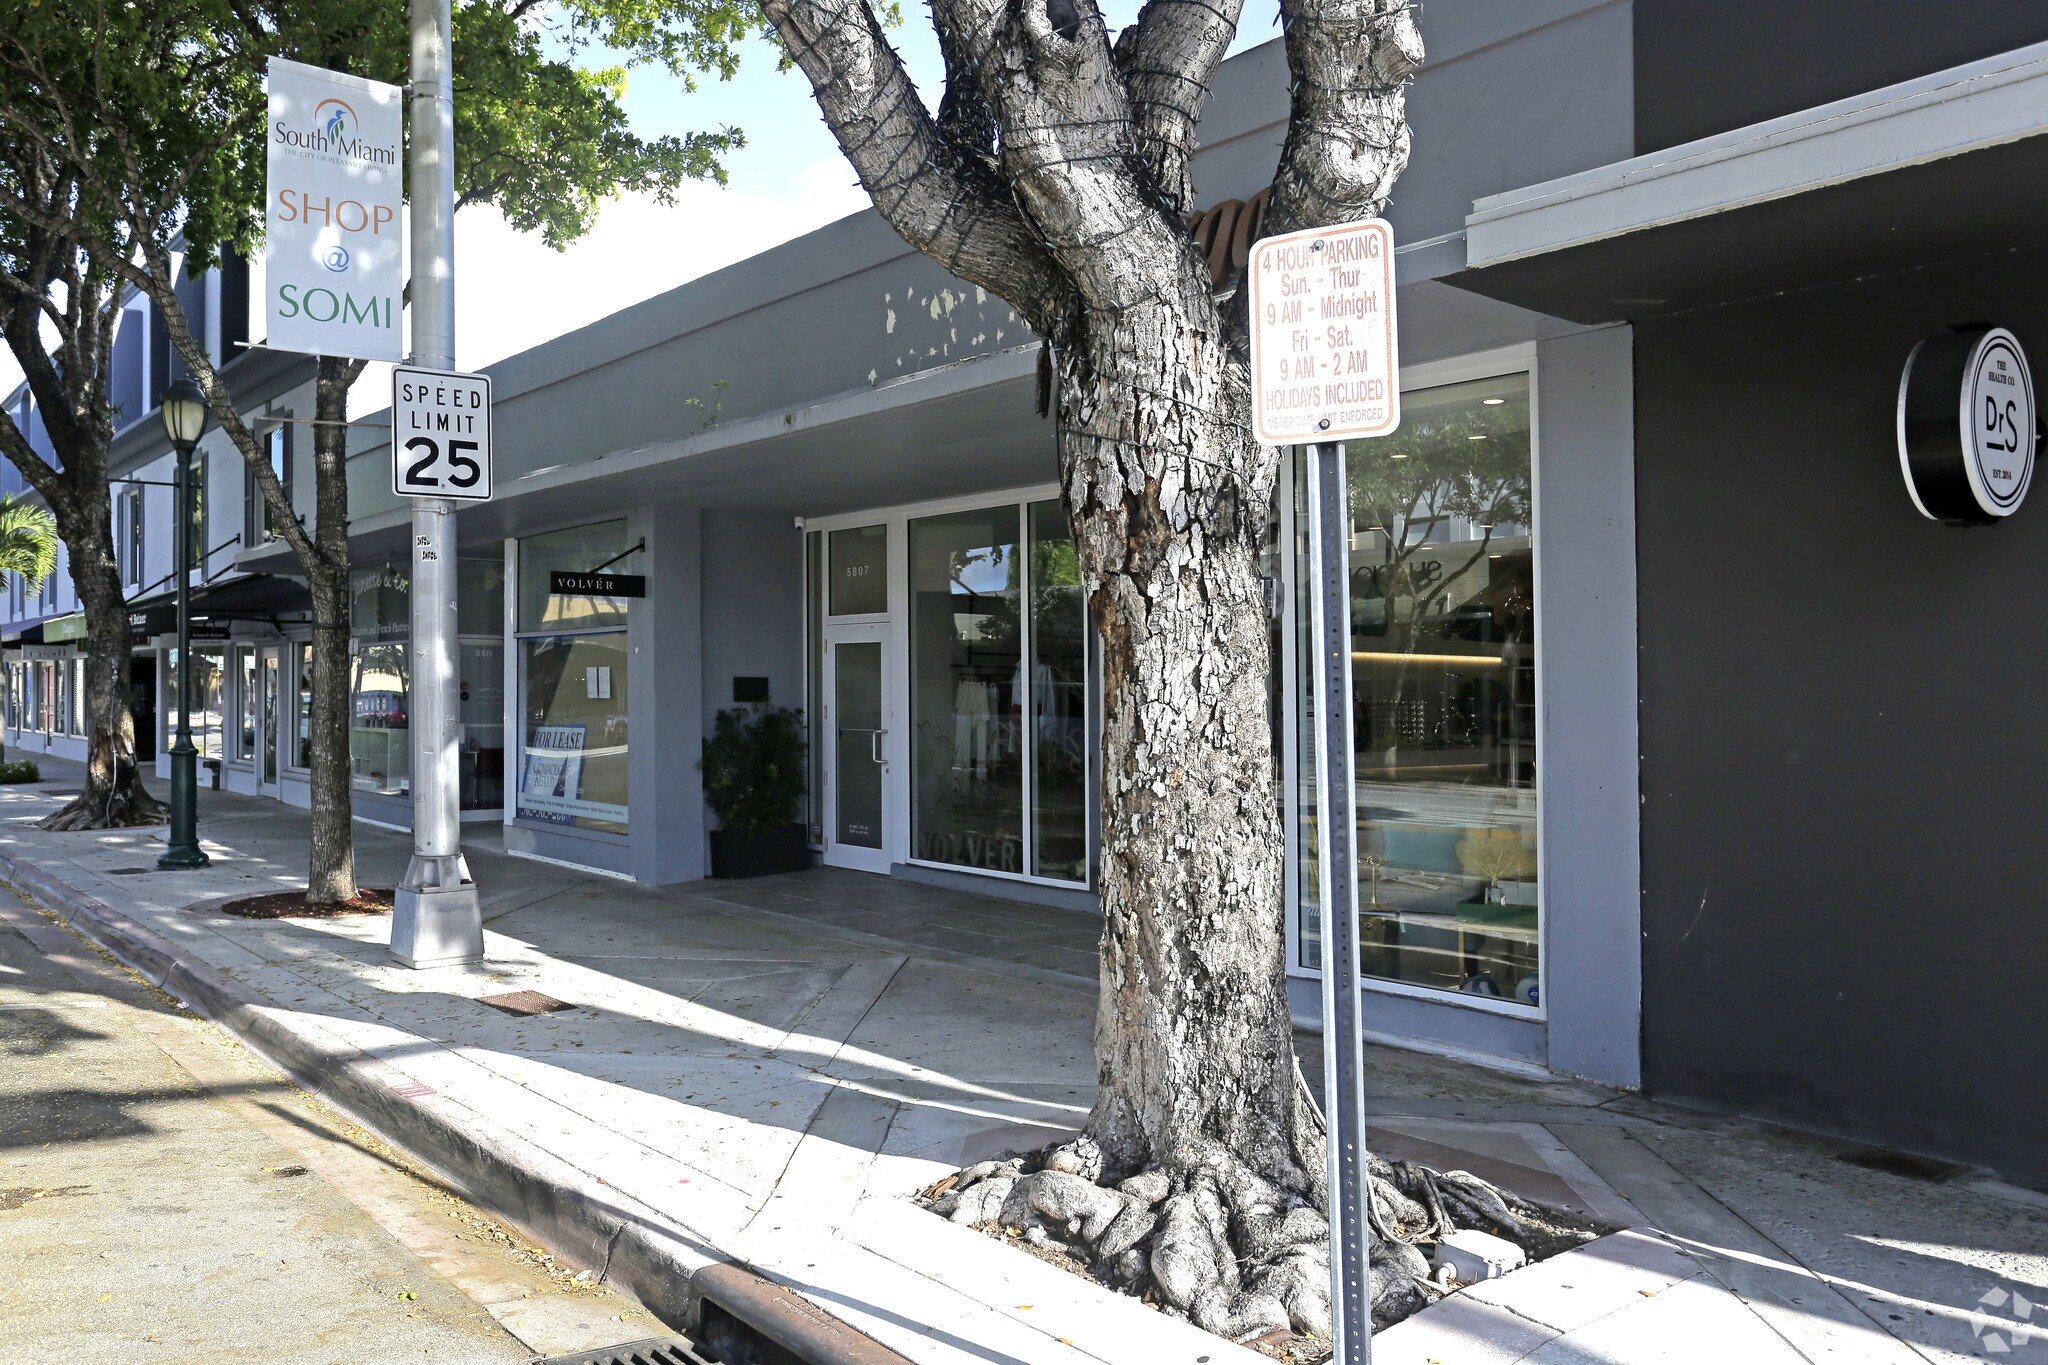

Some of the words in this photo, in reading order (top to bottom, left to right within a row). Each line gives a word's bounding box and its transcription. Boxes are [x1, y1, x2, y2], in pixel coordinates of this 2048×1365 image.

[275, 121, 328, 152] South
[338, 136, 394, 165] Miami
[284, 148, 298, 157] THE
[299, 151, 316, 160] CITY
[316, 154, 327, 162] OF
[328, 157, 362, 169] PLEASANT
[363, 164, 388, 174] LIVING
[278, 189, 393, 235] SHOP
[322, 245, 350, 273] @
[1263, 251, 1272, 273] 4
[1277, 246, 1315, 272] HOUR
[1320, 233, 1379, 266] PARKING
[1281, 273, 1311, 297] Sun.
[1329, 265, 1361, 290] Thur
[278, 284, 391, 329] SOMI
[1267, 303, 1276, 326] 9
[1282, 300, 1302, 324] AM
[1320, 290, 1378, 321] Midnight
[1292, 329, 1309, 352] Fri
[1327, 325, 1353, 349] Sat.
[1280, 358, 1289, 381] 9
[1295, 355, 1315, 380] AM
[1333, 352, 1342, 376] 2
[1347, 349, 1368, 374] AM
[1988, 371, 2007, 385] HEALTH
[1996, 360, 2007, 371] THE
[402, 383, 481, 409] SPEED
[1266, 385, 1321, 411] HOLIDAYS
[1325, 378, 1384, 406] INCLUDED
[411, 410, 474, 434] LIMIT
[1268, 416, 1294, 430] METER
[1296, 413, 1315, 427] TIME
[1340, 407, 1384, 423] ENFORCED
[404, 436, 481, 488] 25
[846, 565, 869, 578] 5807
[475, 649, 493, 658] 5811
[534, 731, 552, 748] FOR
[552, 732, 582, 749] LEASE
